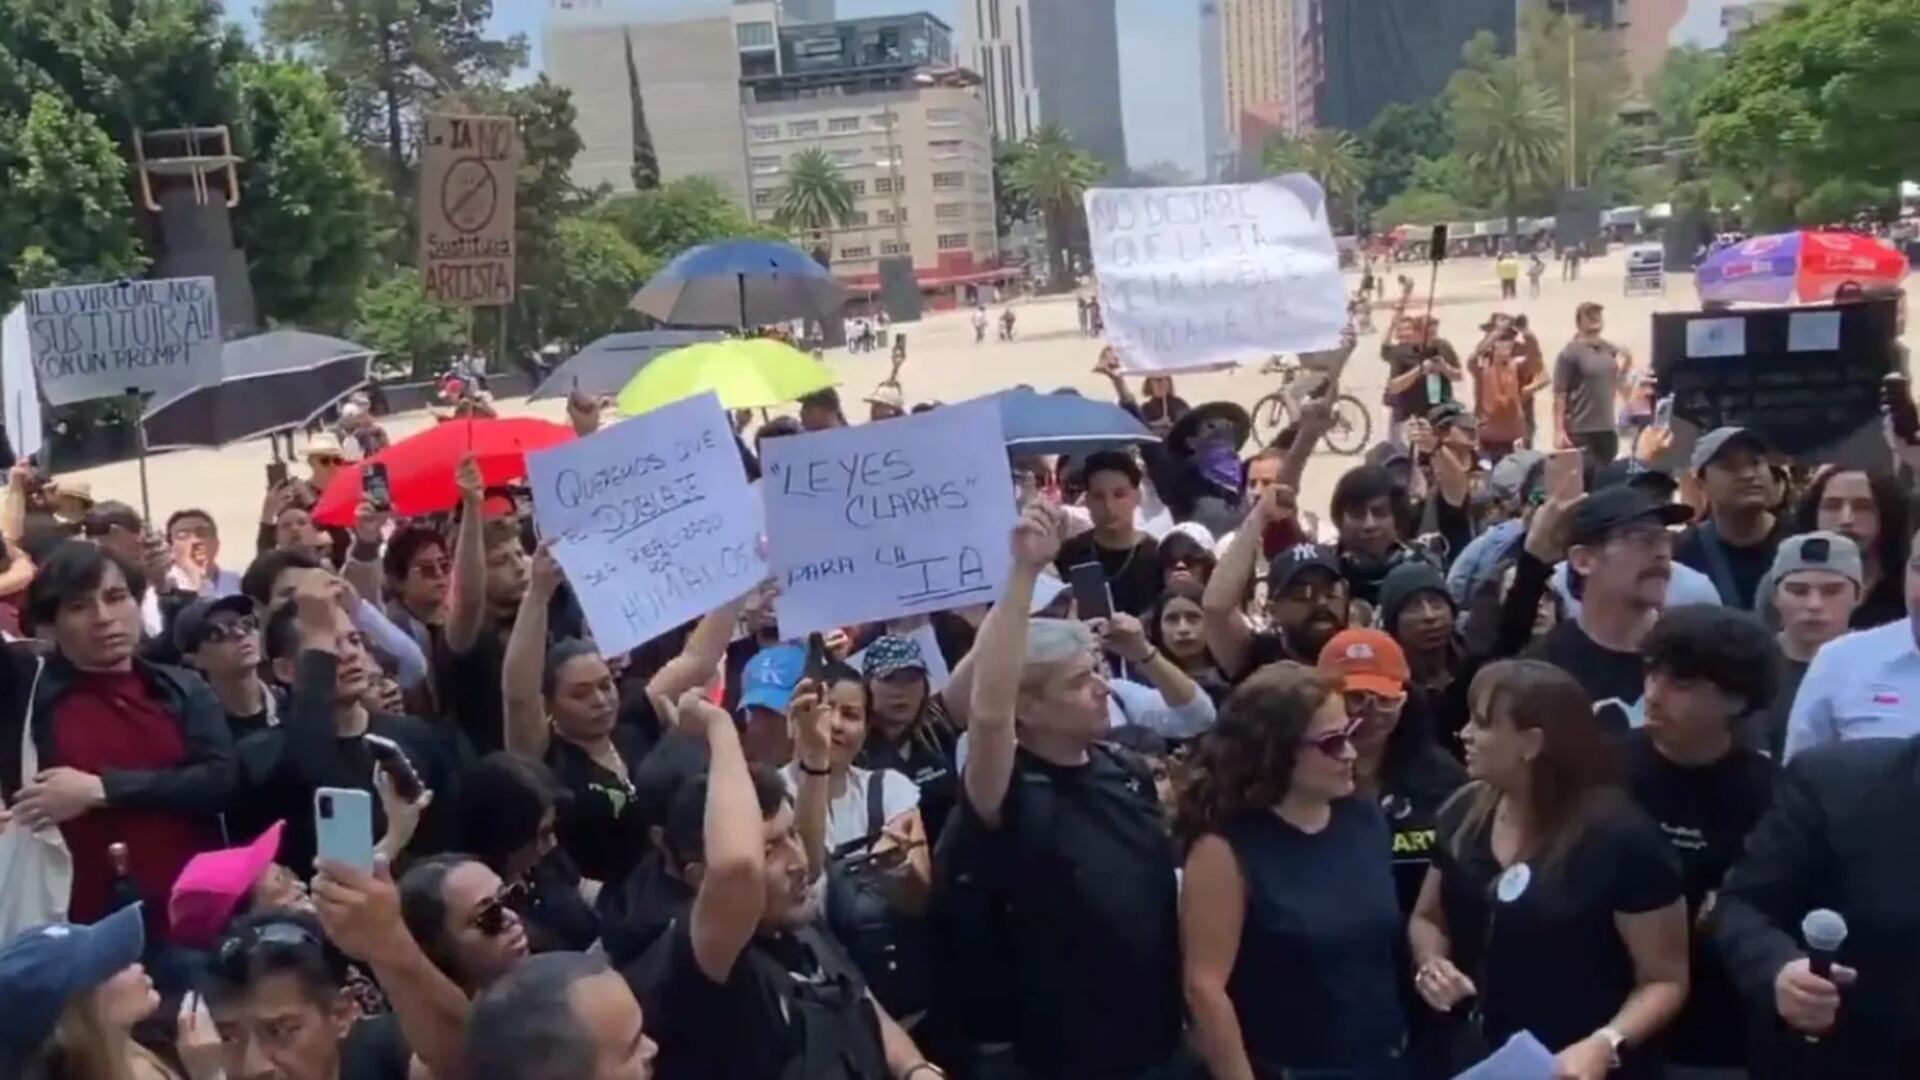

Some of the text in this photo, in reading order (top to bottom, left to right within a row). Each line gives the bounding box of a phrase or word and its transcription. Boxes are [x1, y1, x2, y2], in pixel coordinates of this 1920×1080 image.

[450, 119, 473, 149] IA
[1093, 196, 1136, 232] NO
[1178, 229, 1213, 263] LA
[75, 282, 165, 312] VIRTUAL
[424, 262, 512, 300] ARTISTA
[77, 352, 108, 374] UN
[114, 344, 192, 370] PROMPT
[555, 453, 666, 508] QUEREMOS
[787, 545, 984, 600] PARA LA IA
